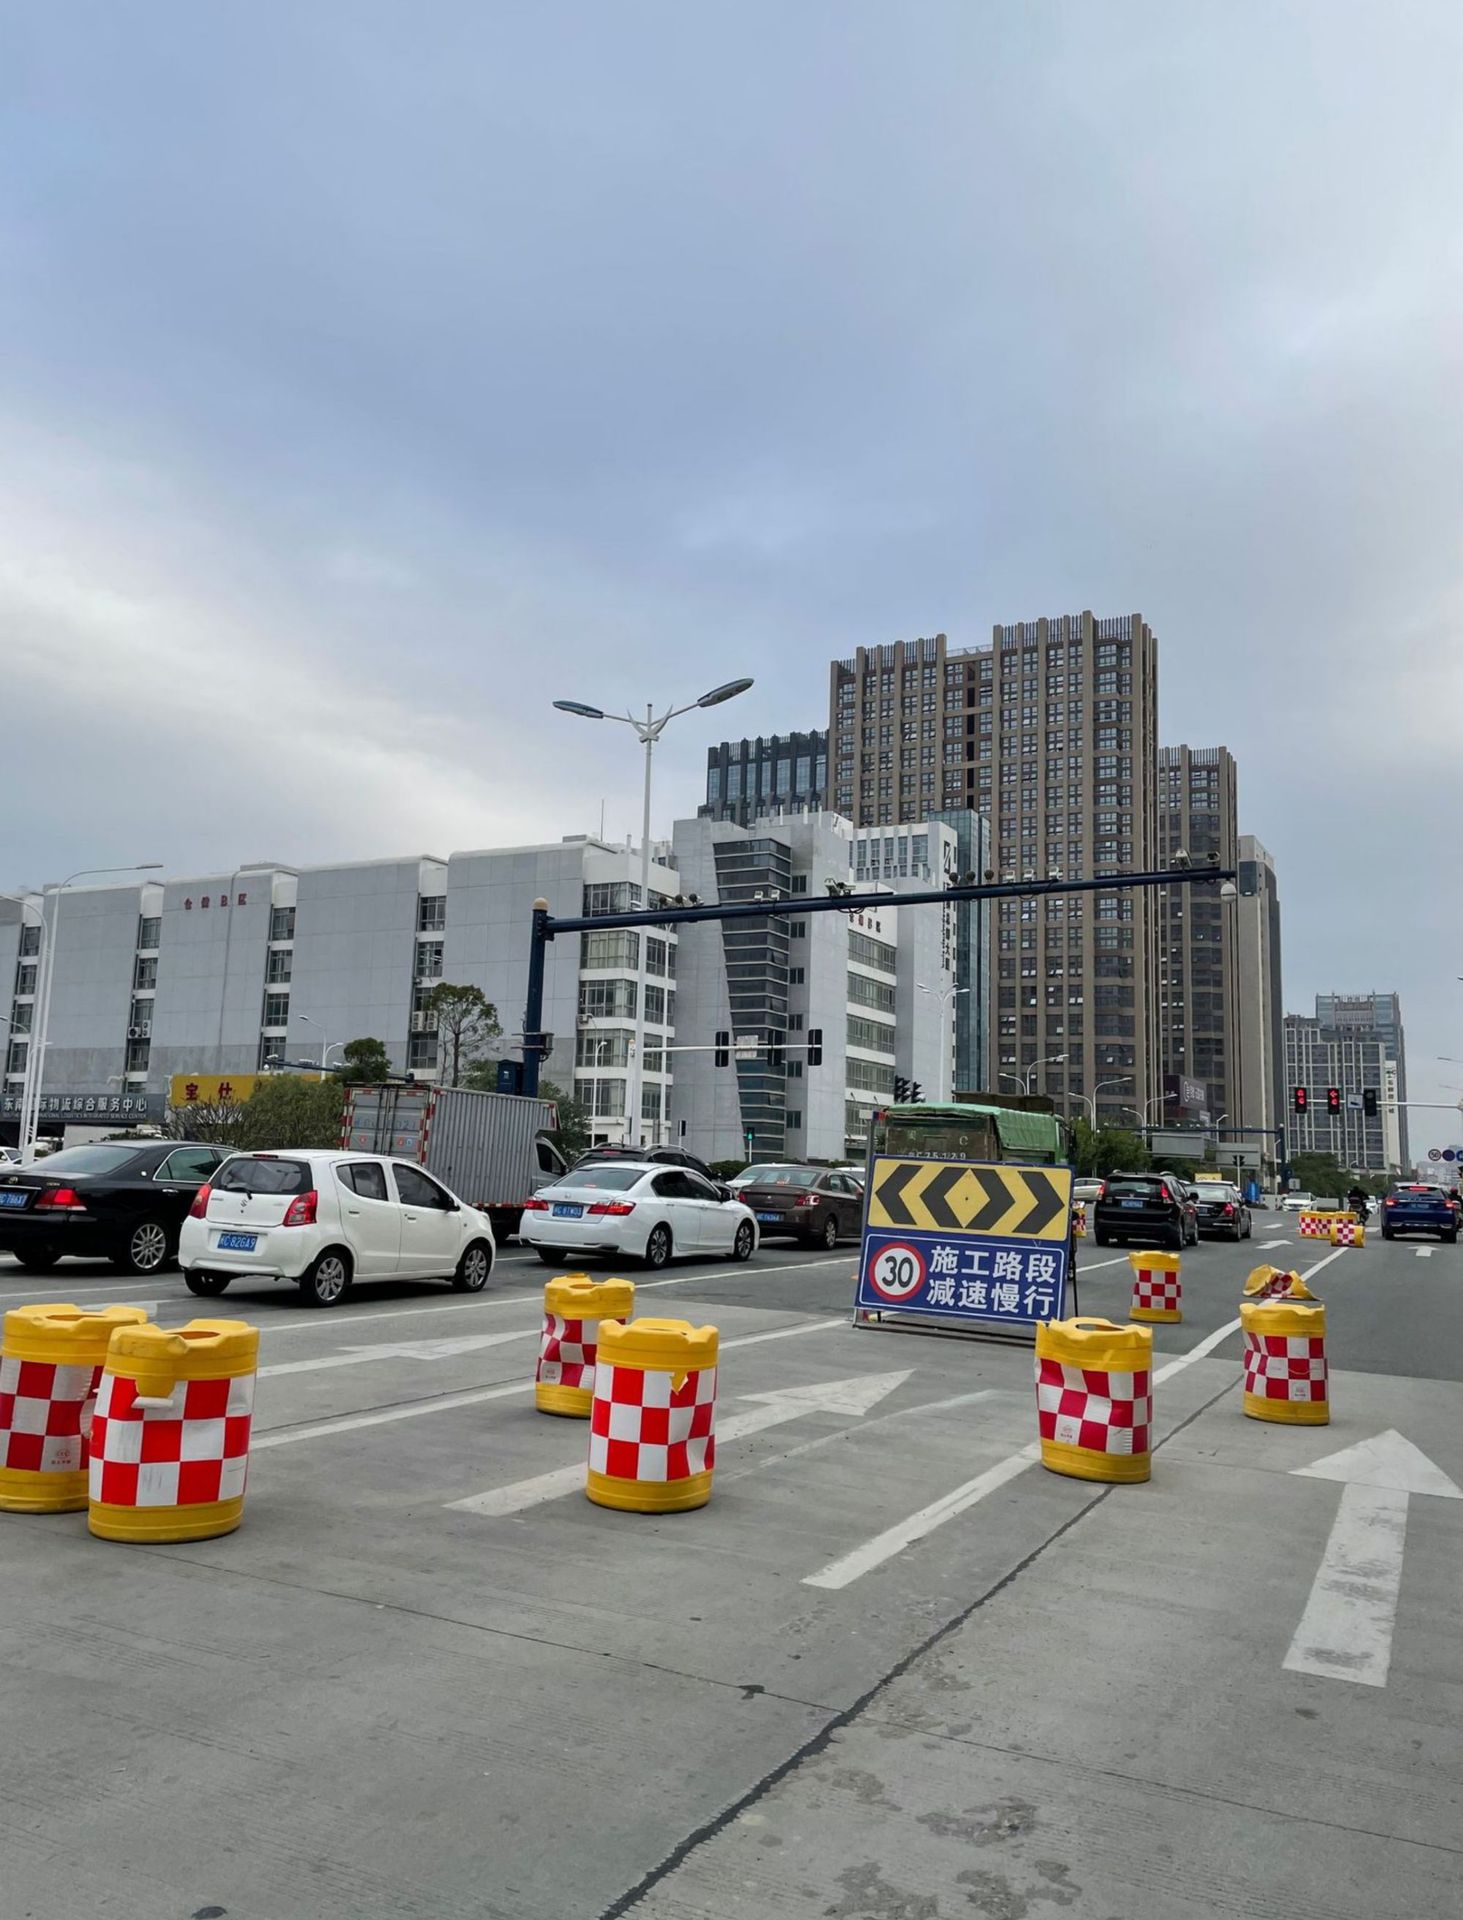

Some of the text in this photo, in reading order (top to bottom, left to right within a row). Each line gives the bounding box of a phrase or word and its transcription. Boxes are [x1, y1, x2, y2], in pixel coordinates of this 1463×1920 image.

[4, 1096, 147, 1112] 东南际物流综合服务中心
[882, 1256, 914, 1289] 30
[928, 1245, 1057, 1284] 施工路段
[926, 1278, 1055, 1316] 减速慢行
